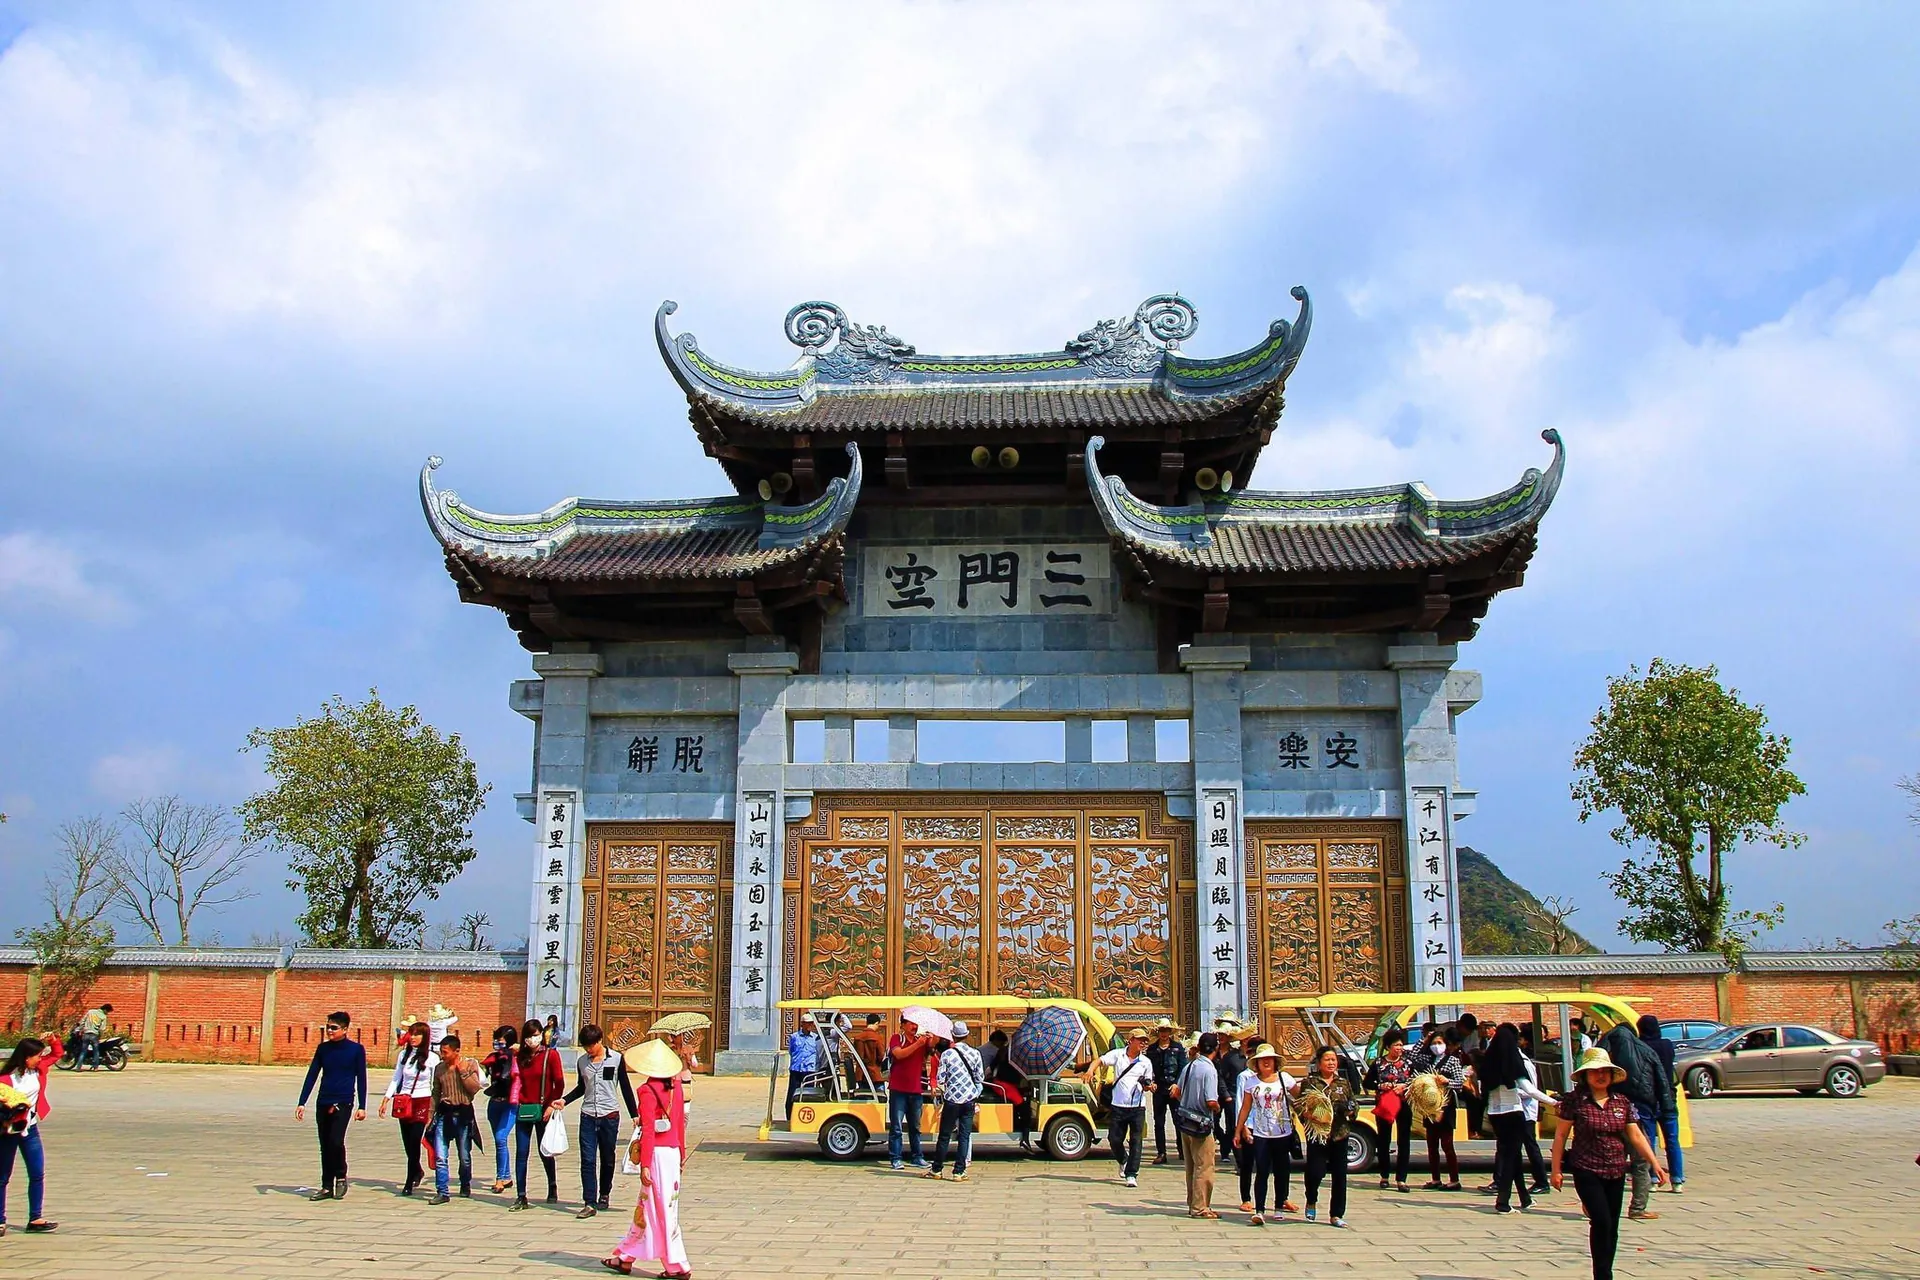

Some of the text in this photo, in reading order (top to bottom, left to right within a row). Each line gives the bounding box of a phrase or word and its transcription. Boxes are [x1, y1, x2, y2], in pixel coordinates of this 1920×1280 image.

[541, 803, 567, 989] 萬里無雲萬里天
[1210, 801, 1235, 992] 日照月臨金世界
[1418, 799, 1446, 989] 千江有水千江月
[801, 1109, 813, 1121] 75
